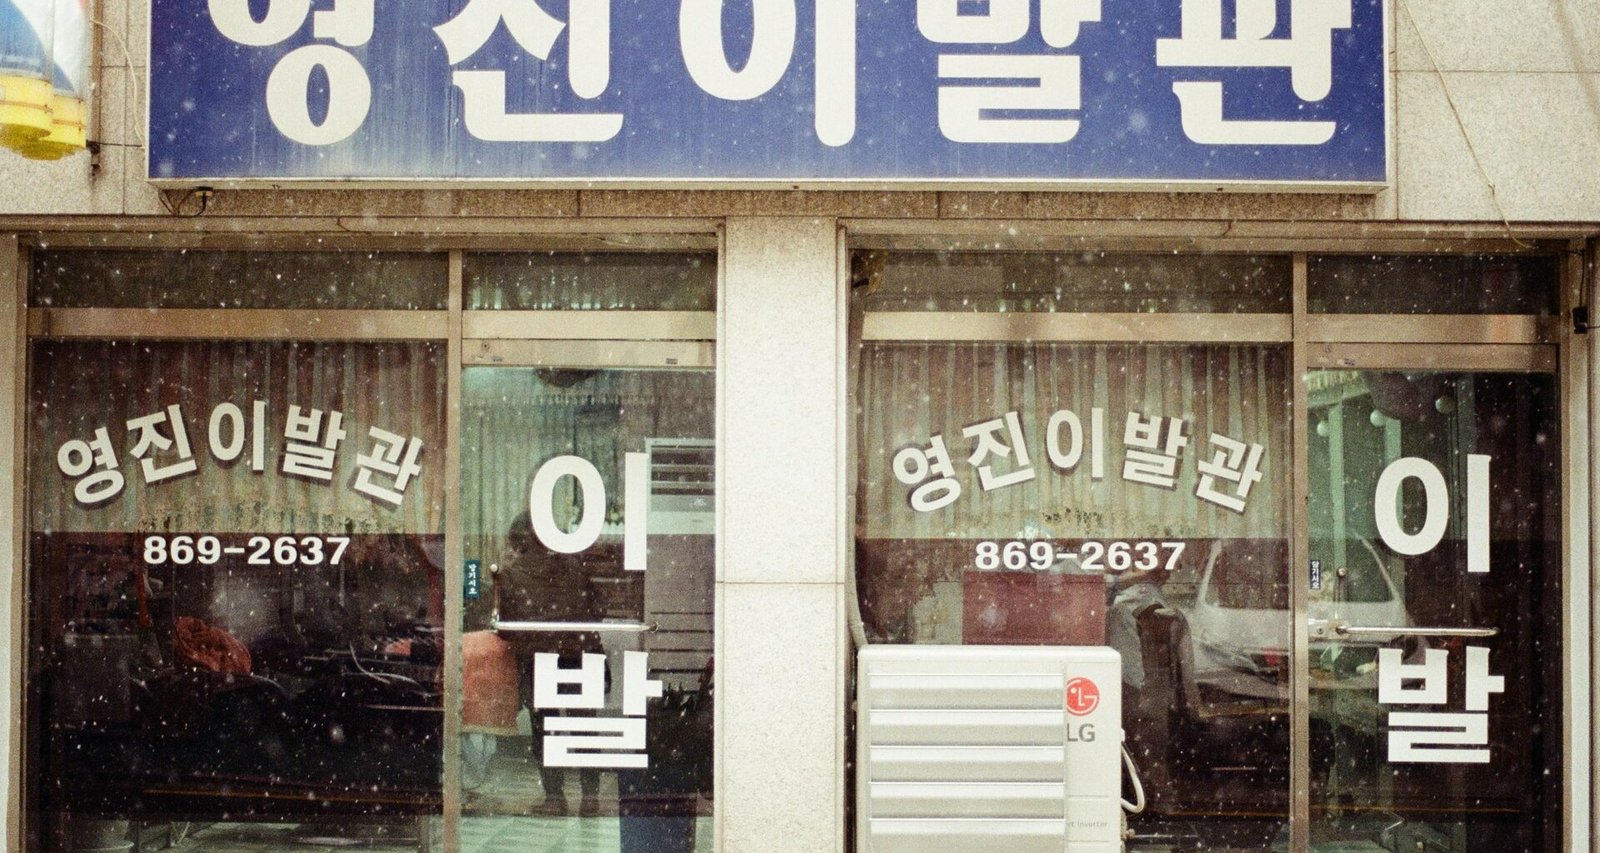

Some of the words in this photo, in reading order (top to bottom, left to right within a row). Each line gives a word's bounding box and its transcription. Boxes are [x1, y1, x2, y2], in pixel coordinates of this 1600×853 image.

[57, 400, 423, 505] 영진이발관
[892, 407, 1264, 513] 영진이발관
[143, 535, 350, 565] 869-2637
[974, 541, 1186, 570] 869-2637
[1066, 723, 1096, 743] LG
